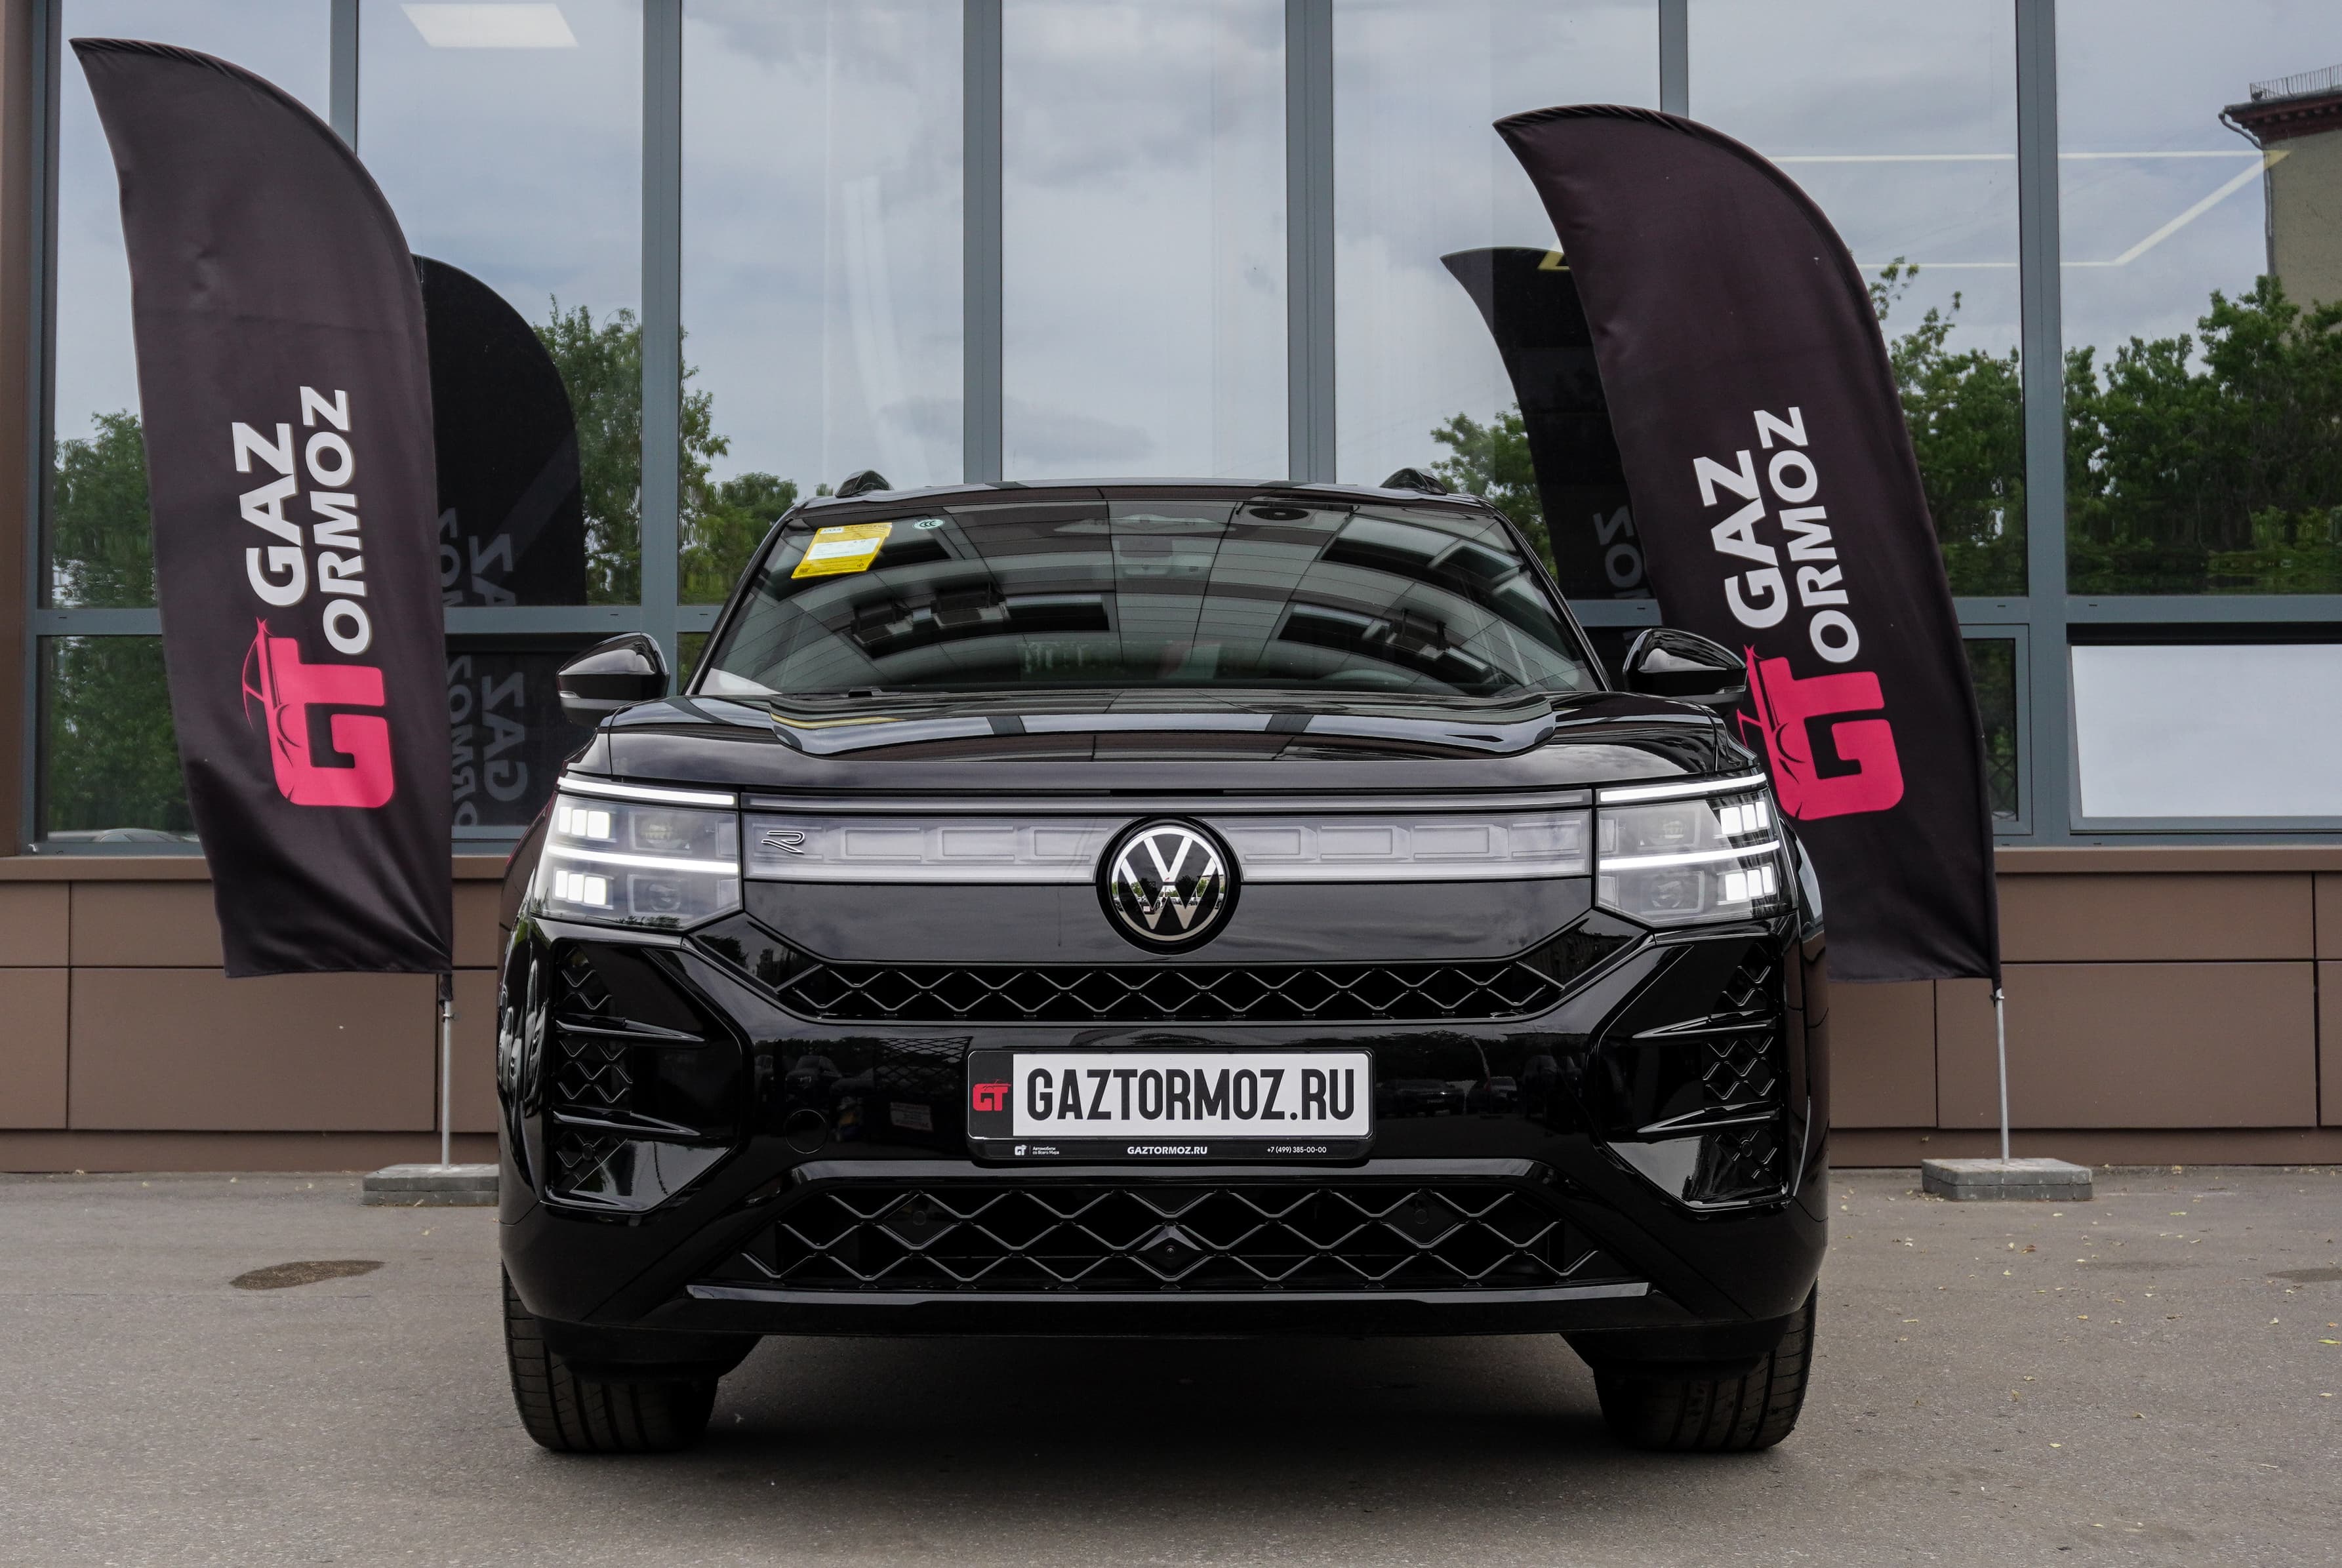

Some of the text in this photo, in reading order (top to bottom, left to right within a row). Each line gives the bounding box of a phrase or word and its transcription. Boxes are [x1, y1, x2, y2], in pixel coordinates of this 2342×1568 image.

[232, 422, 306, 606] GAZ
[300, 386, 370, 654] ORMOZ
[1693, 449, 1788, 628] GAZ
[1753, 407, 1859, 662] ORMOZ
[973, 1081, 1011, 1111] GT
[1027, 1068, 1354, 1121] GAZTORMOZ.RU
[1127, 1146, 1208, 1155] GAZTORMOZ.RU
